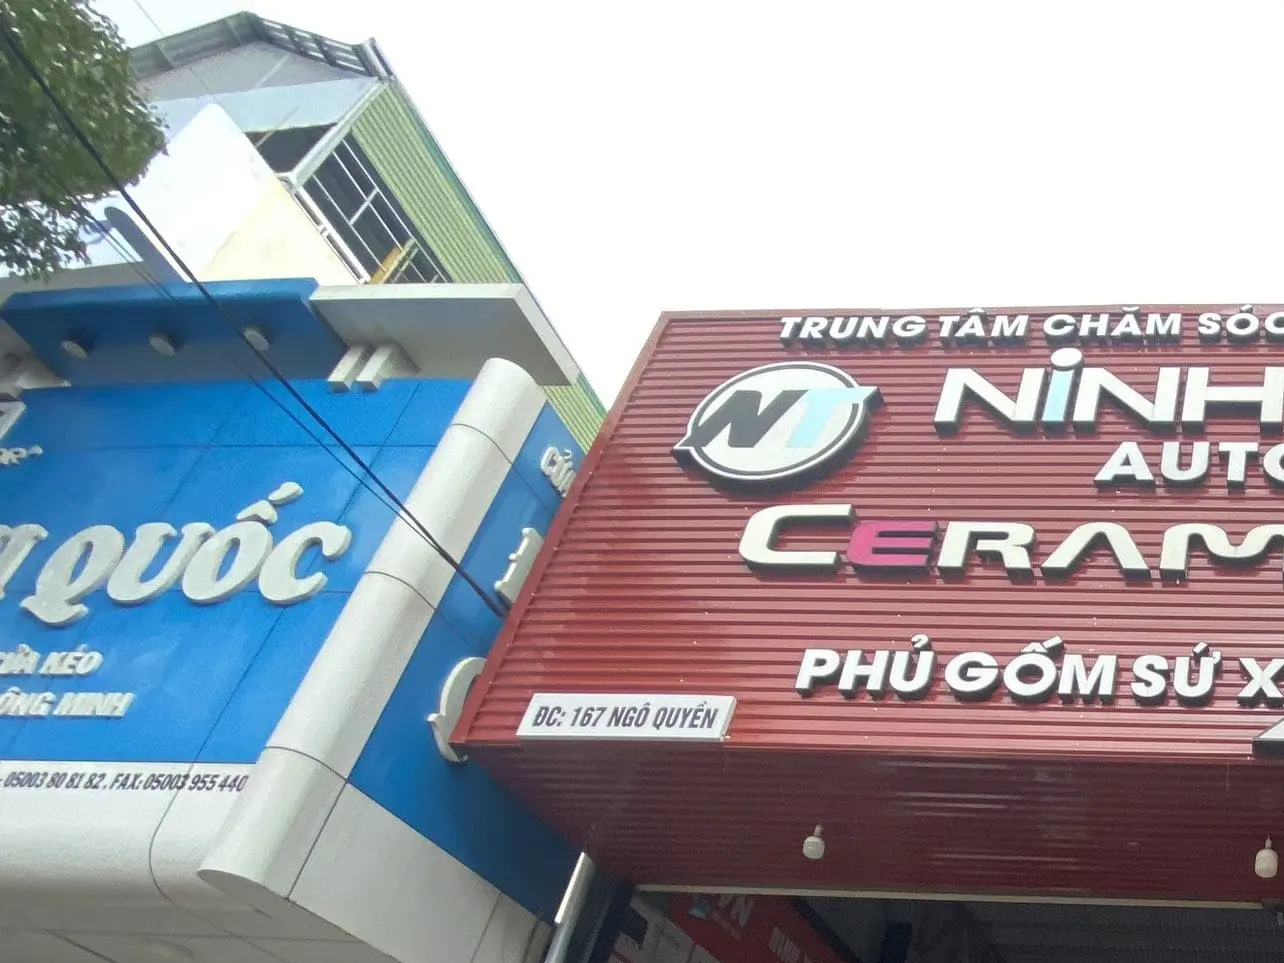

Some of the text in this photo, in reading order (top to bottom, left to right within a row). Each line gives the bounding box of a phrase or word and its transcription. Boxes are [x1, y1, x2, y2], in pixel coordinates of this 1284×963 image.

[779, 315, 927, 342] TRUNG
[939, 308, 1030, 340] TÂM
[1042, 307, 1182, 338] CHĂM
[21, 481, 353, 628] QUỐC
[39, 643, 104, 676] KÉO
[797, 635, 935, 696] PHỦ
[944, 635, 1120, 698] GỐM
[1131, 640, 1223, 699] SỨ
[53, 691, 135, 718] MINH
[532, 699, 718, 733] ĐC: 167 NGÔ QUYỀN
[3, 771, 45, 788] 05003
[46, 772, 67, 788] 80
[66, 772, 82, 788] 81
[109, 773, 142, 790] FAX:
[142, 774, 188, 791] 05003
[188, 775, 220, 791] 955
[219, 775, 249, 792] 440
